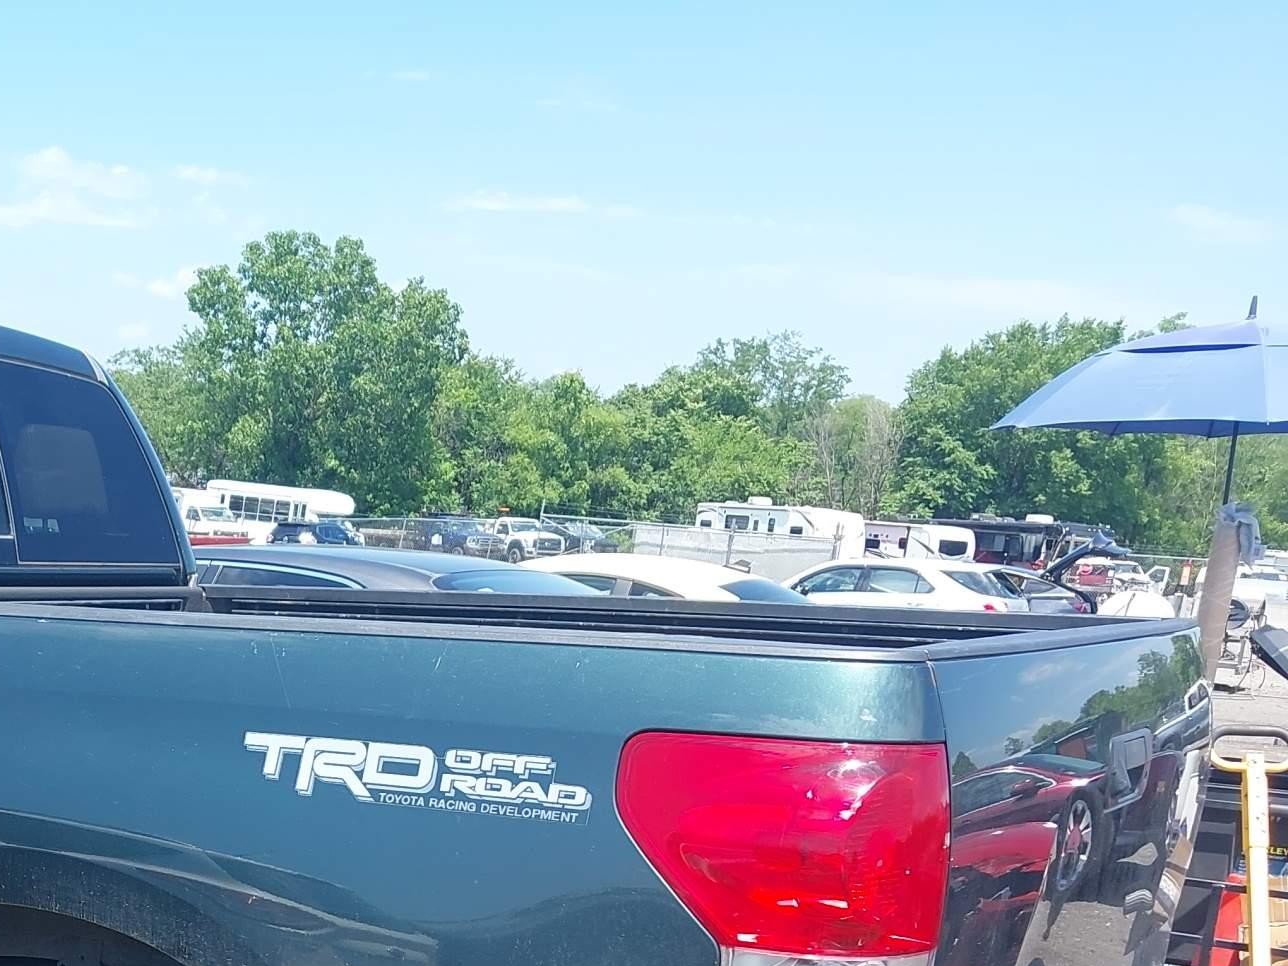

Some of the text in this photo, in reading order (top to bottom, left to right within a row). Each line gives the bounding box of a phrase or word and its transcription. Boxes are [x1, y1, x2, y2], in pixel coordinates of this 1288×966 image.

[244, 731, 439, 801] TRD
[444, 748, 556, 778] OFF
[378, 792, 579, 824] TOYOTA RACING DEVELOPMENT
[439, 774, 592, 811] ROAD
